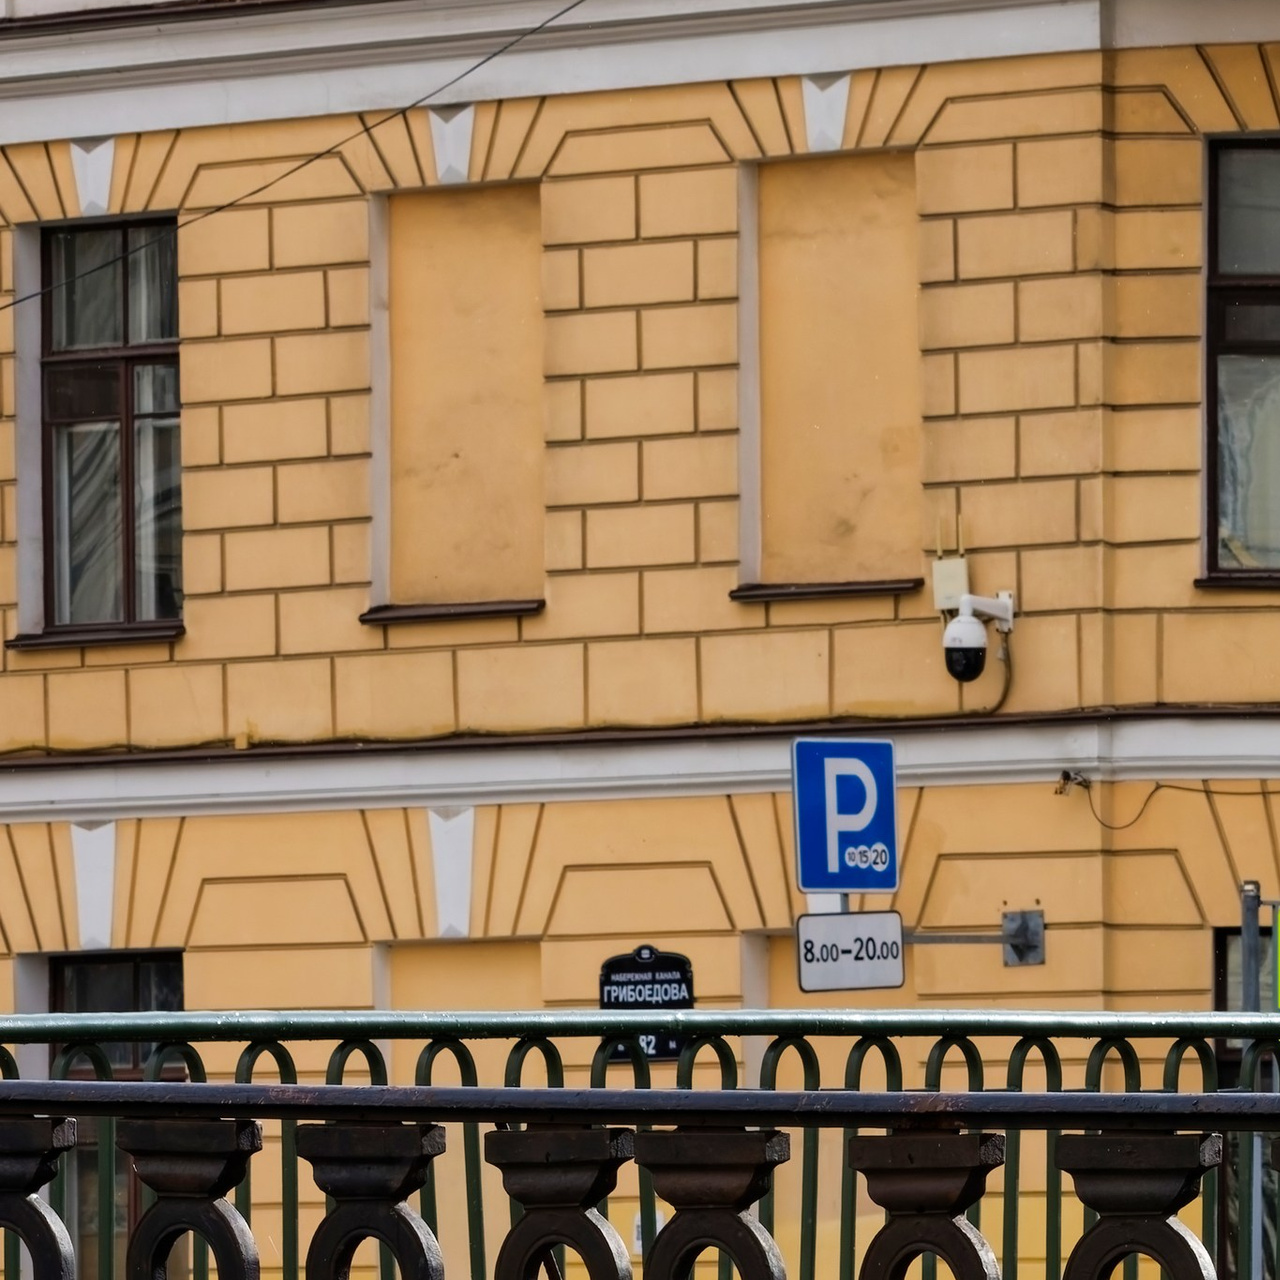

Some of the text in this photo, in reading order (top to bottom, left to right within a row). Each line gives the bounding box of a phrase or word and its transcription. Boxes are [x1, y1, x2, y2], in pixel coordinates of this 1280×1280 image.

[824, 757, 878, 873] P
[847, 849, 888, 865] 10 15 20
[611, 971, 682, 982] НАБЕРЕЖНАЯ КАНАЛА
[603, 983, 689, 1004] ГРИБОЕДОВА
